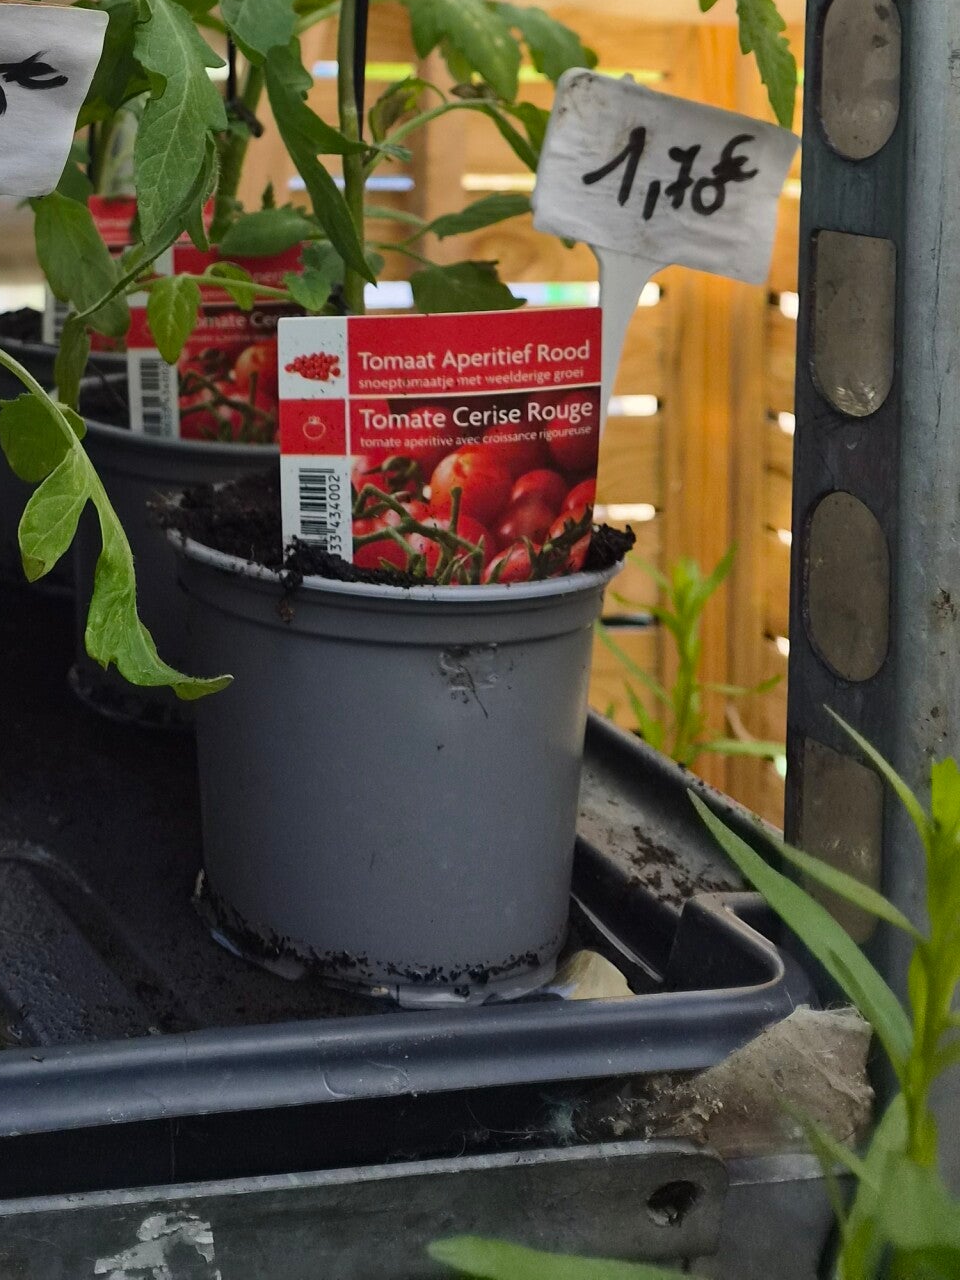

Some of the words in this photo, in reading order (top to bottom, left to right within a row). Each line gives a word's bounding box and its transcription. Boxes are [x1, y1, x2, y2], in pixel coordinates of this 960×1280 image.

[581, 126, 759, 222] 1,70€
[357, 351, 436, 371] Tomaat
[441, 342, 534, 373] Aperitief
[536, 339, 591, 363] Rood
[358, 375, 454, 391] snoeptomaatje
[456, 374, 482, 386] met
[484, 370, 552, 385] weelderige
[553, 366, 584, 383] groei
[358, 408, 447, 430] Tomate
[452, 405, 521, 428] Cerise
[527, 401, 594, 424] Rouge
[360, 437, 402, 448] tomate
[455, 435, 481, 445] avec
[482, 430, 538, 444] croissance
[538, 425, 592, 442] rigoureuse
